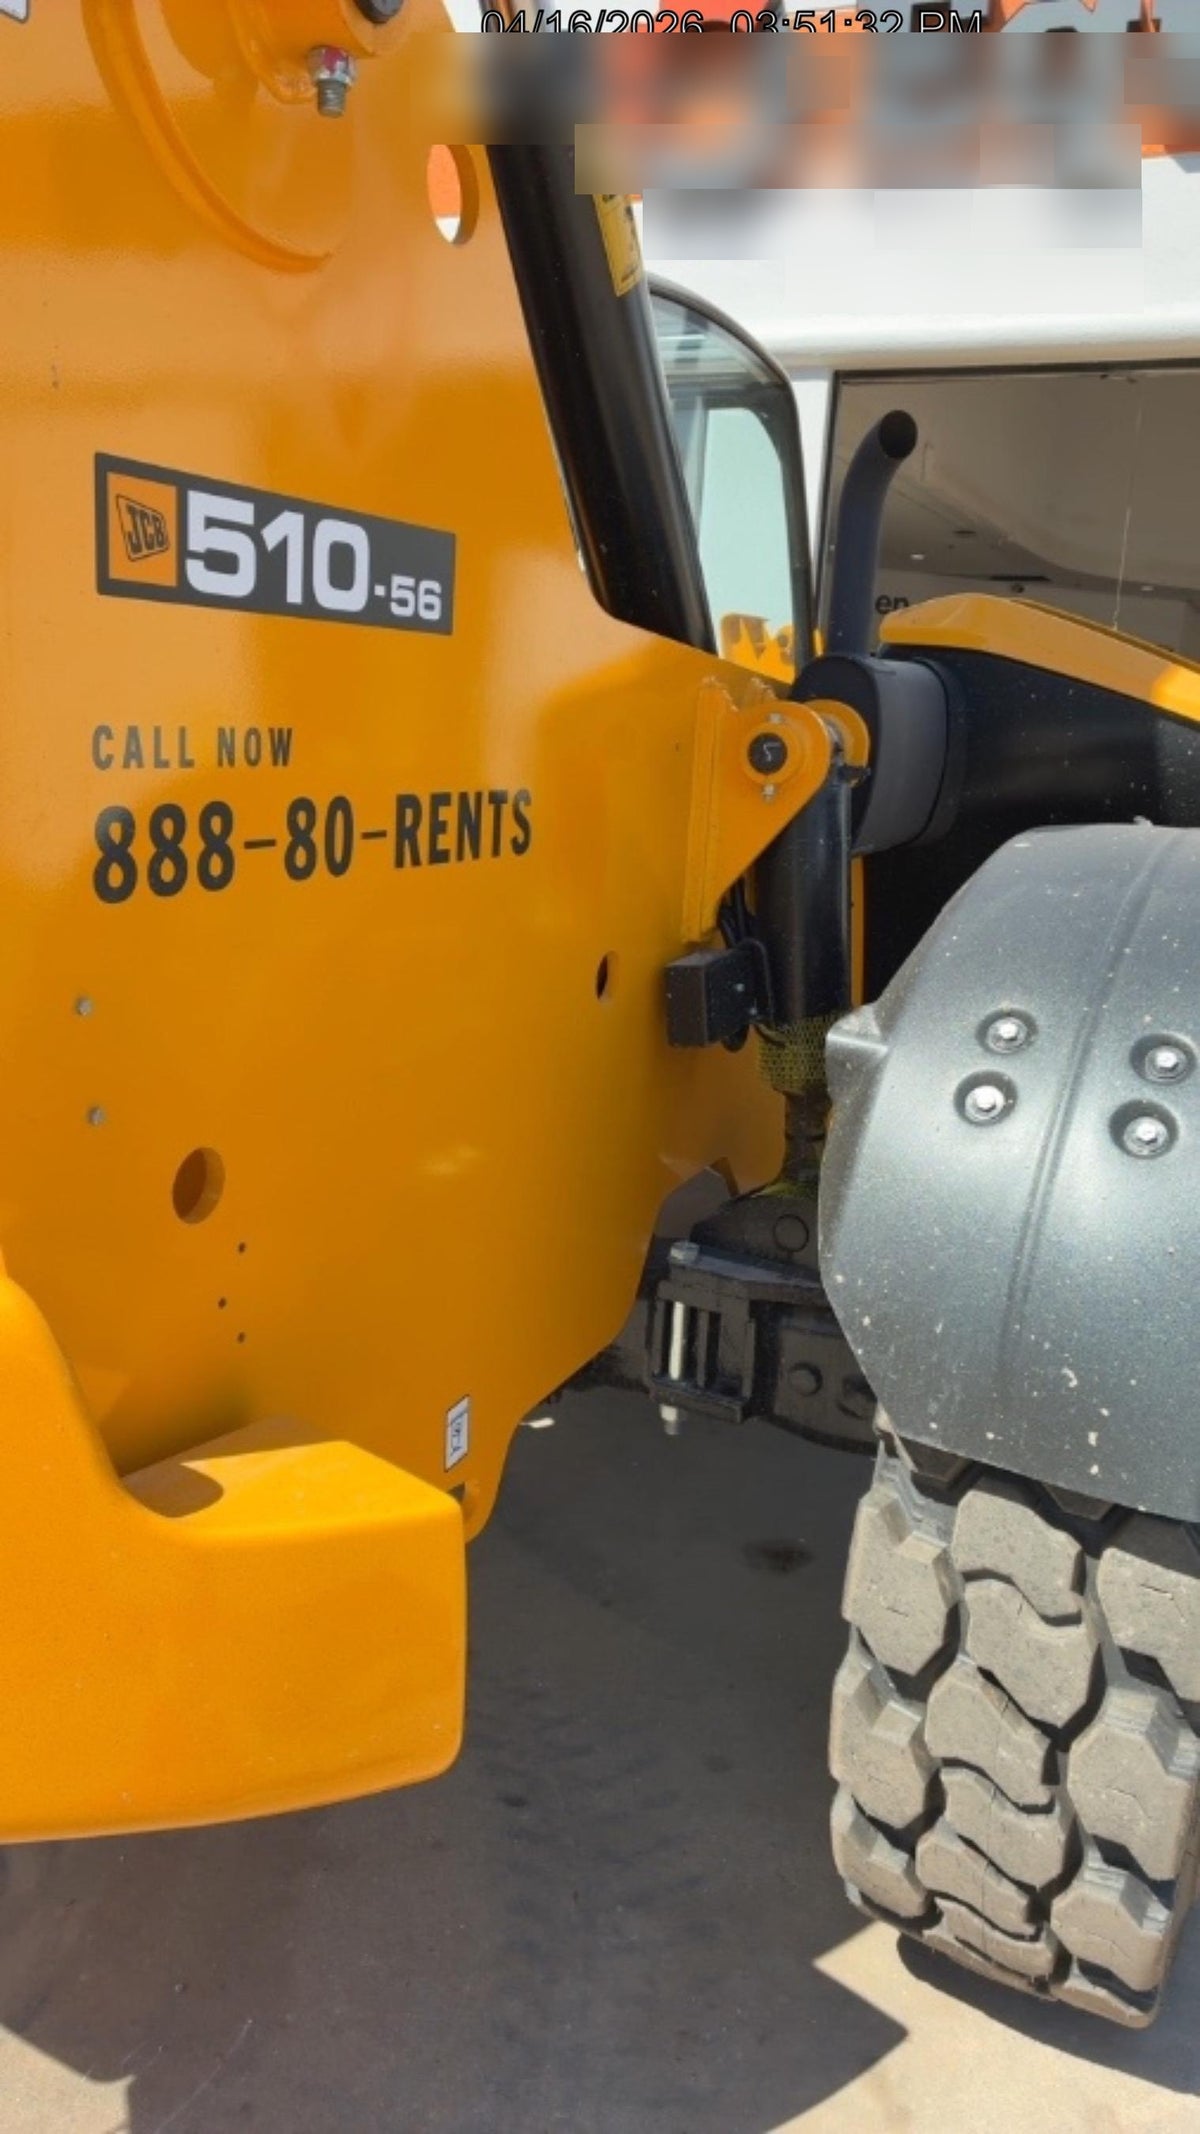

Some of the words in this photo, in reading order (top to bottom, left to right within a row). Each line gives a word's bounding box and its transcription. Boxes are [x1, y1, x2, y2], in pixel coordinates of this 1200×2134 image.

[125, 503, 167, 555] JCB
[92, 725, 195, 770] CALL
[217, 727, 293, 767] NOW
[93, 789, 532, 904] 888-80-RENTS
